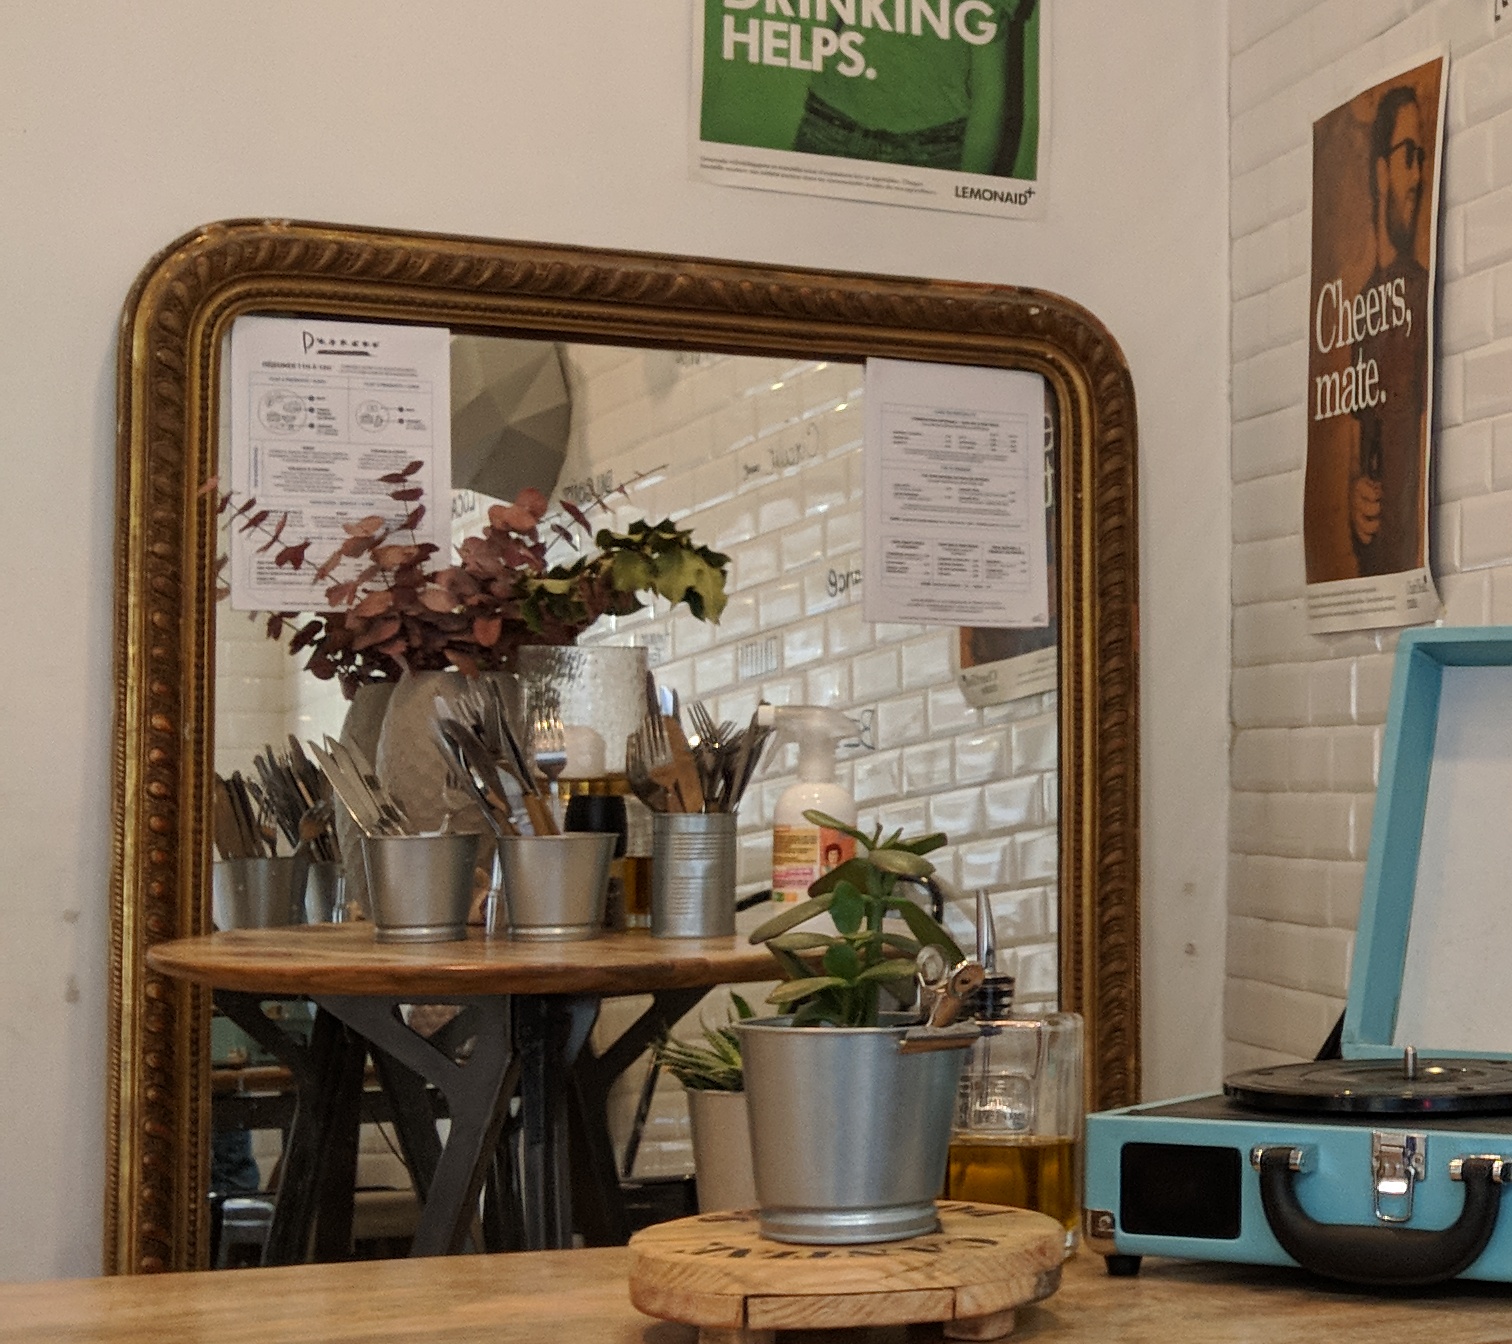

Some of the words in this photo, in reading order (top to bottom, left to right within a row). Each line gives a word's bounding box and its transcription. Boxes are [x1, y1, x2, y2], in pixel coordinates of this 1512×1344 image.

[723, 14, 877, 80] HELPS.
[1316, 276, 1413, 355] Cheers,
[1315, 353, 1387, 422] mate.
